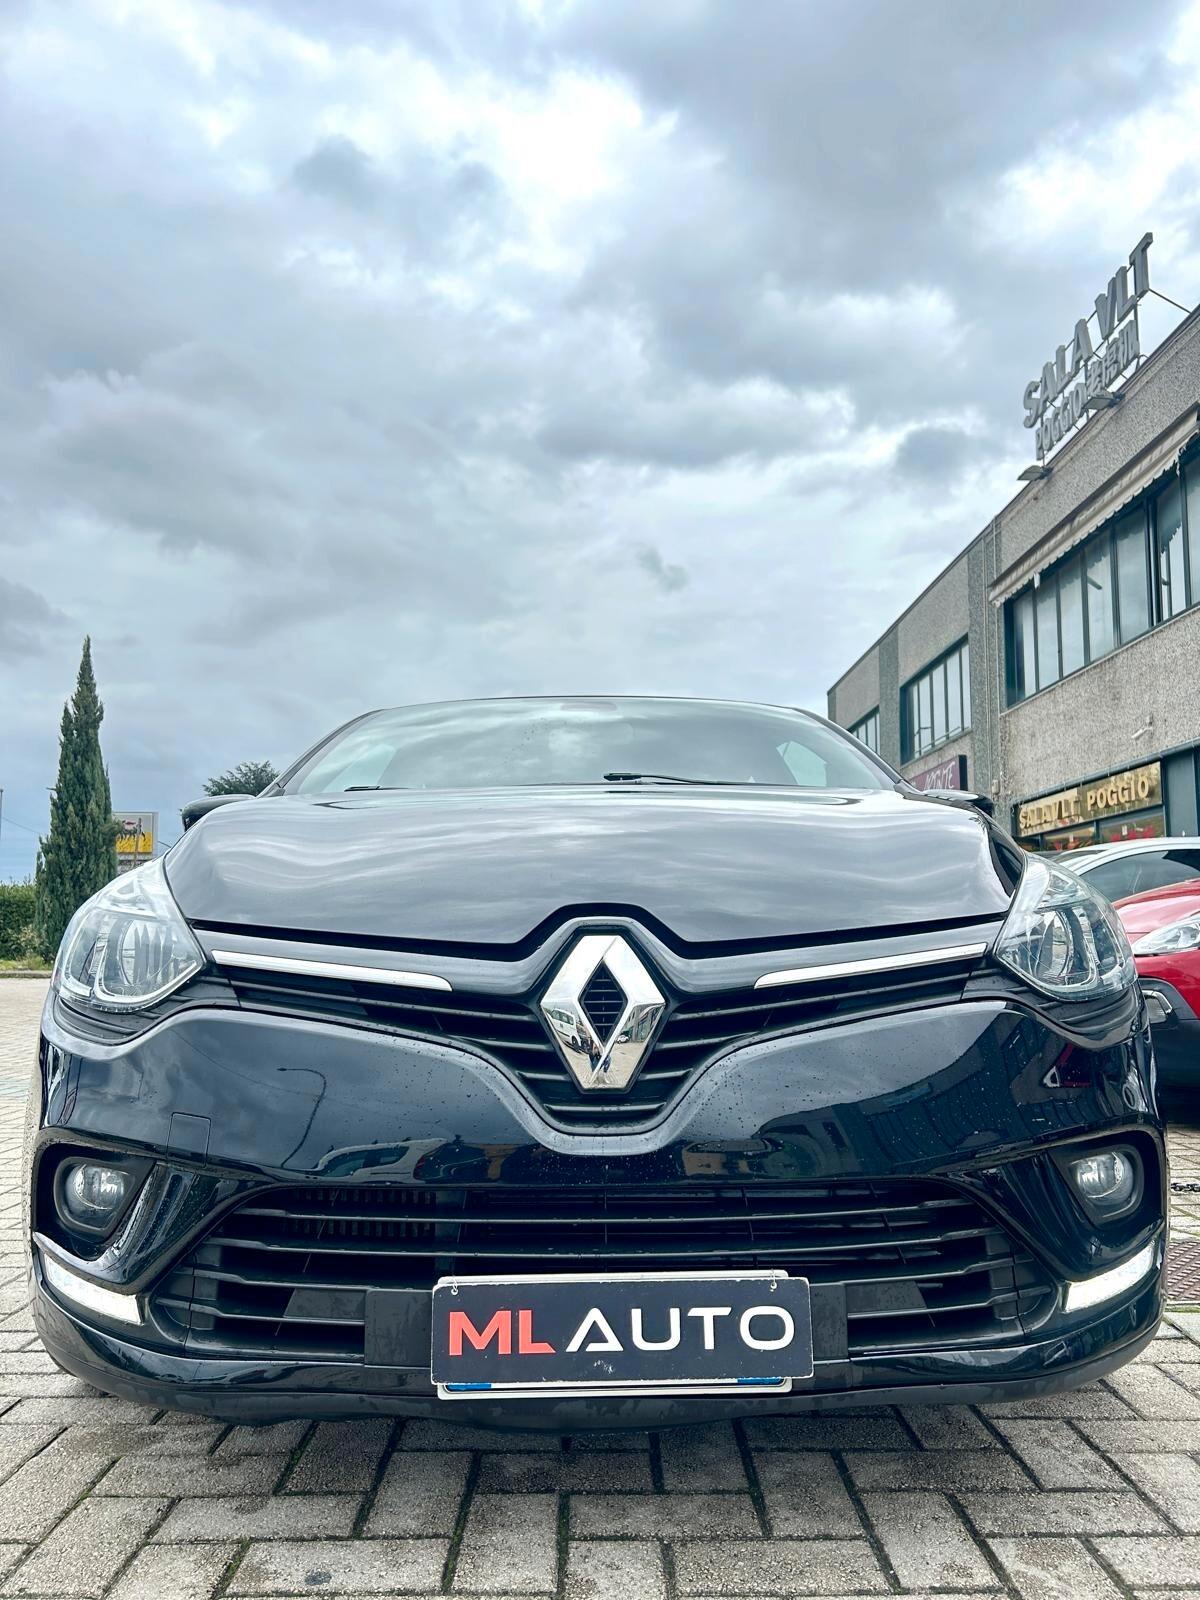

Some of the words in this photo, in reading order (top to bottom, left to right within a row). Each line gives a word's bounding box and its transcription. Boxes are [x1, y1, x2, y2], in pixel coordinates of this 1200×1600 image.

[1023, 318, 1093, 428] SALA
[1095, 232, 1153, 340] VLT
[1035, 382, 1089, 460] POGGIO
[1087, 775, 1149, 812] POGGIO
[448, 1309, 556, 1356] ML
[565, 1305, 795, 1353] AUTO
